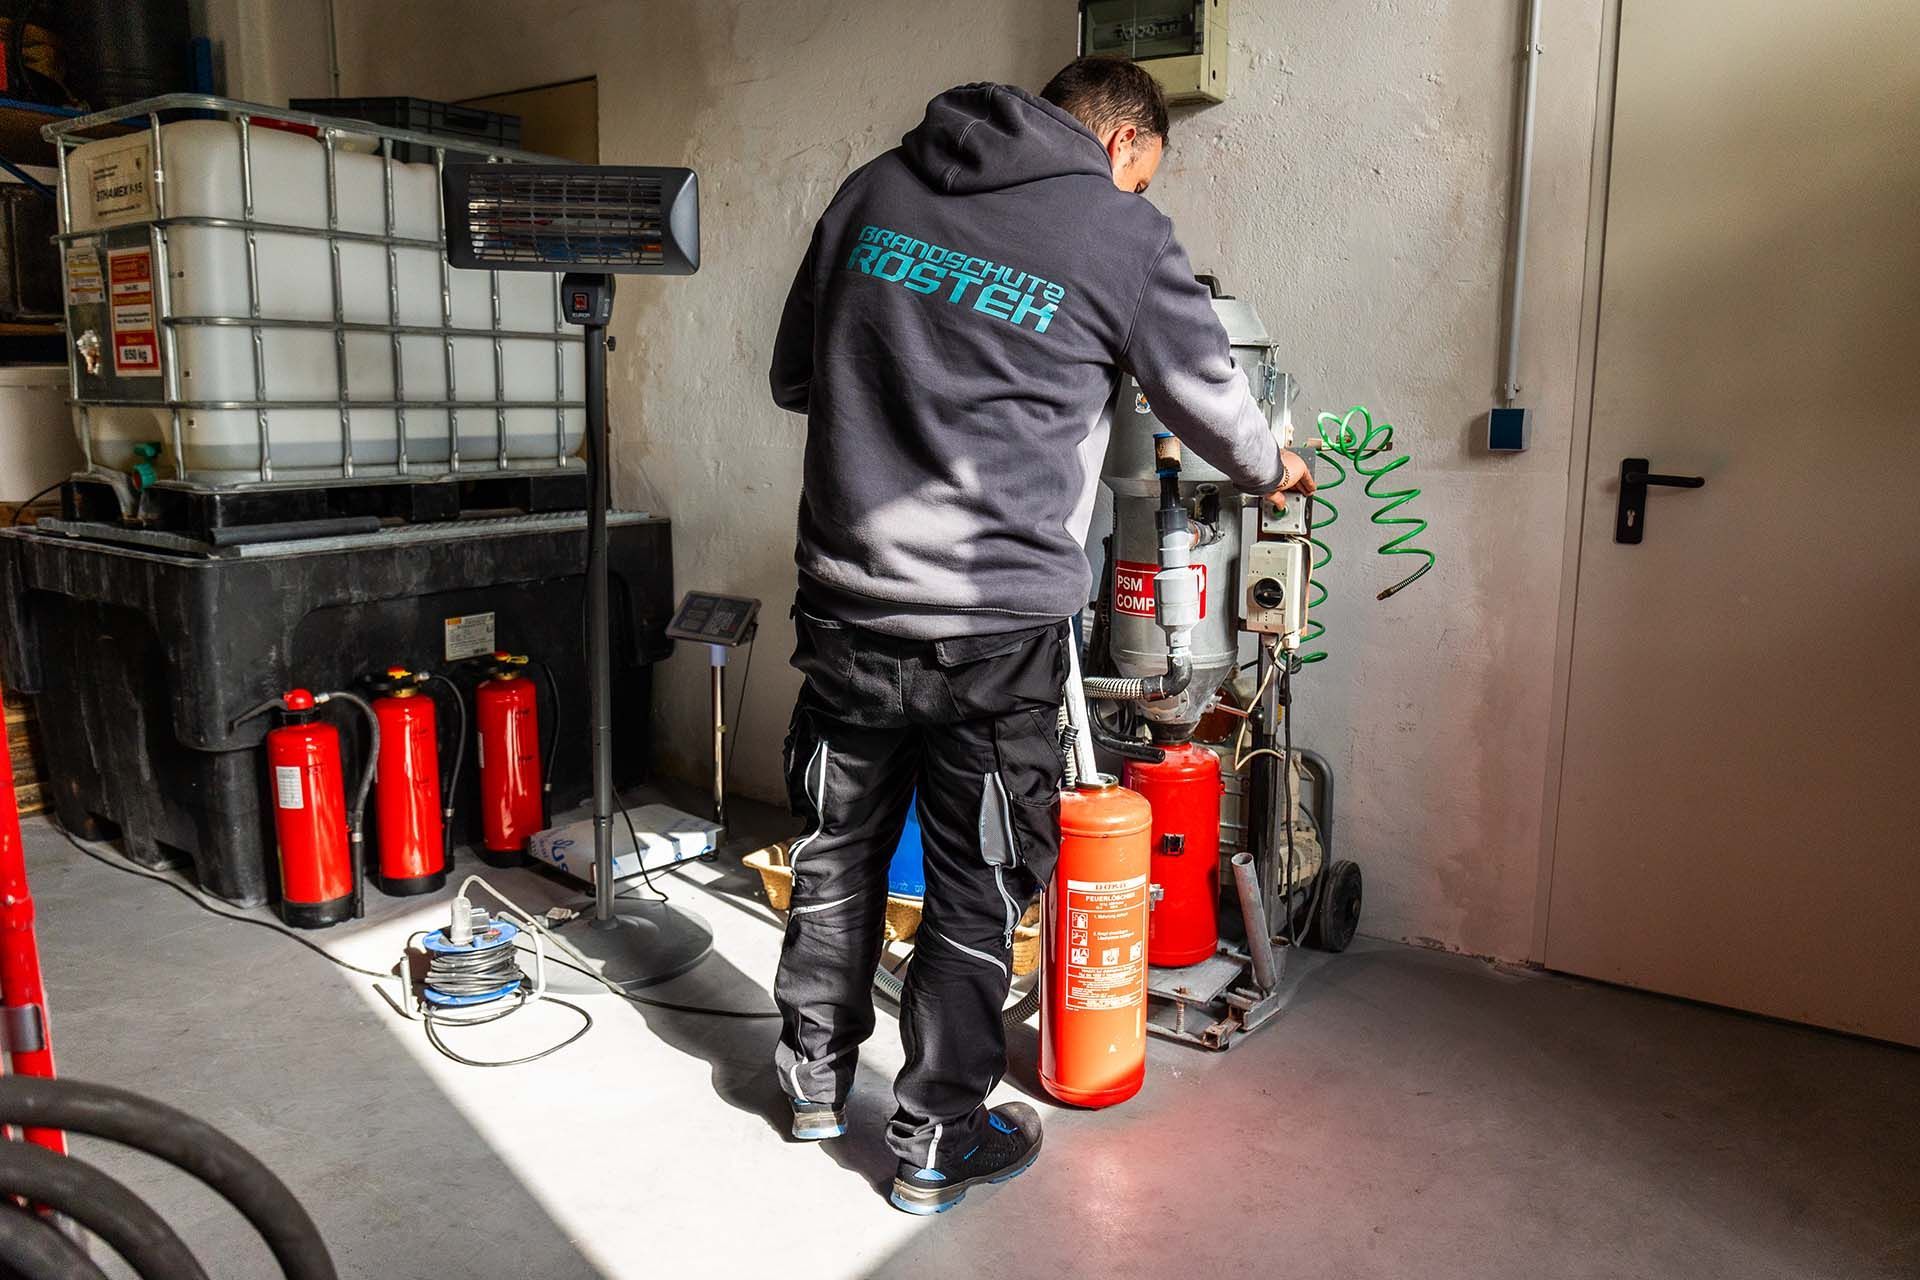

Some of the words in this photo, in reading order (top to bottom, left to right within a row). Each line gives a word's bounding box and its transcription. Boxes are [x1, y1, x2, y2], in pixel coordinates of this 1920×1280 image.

[847, 243, 1059, 334] ROSTEK
[858, 225, 1066, 304] BRANDSCHUTZ
[1117, 574, 1143, 592] PSM
